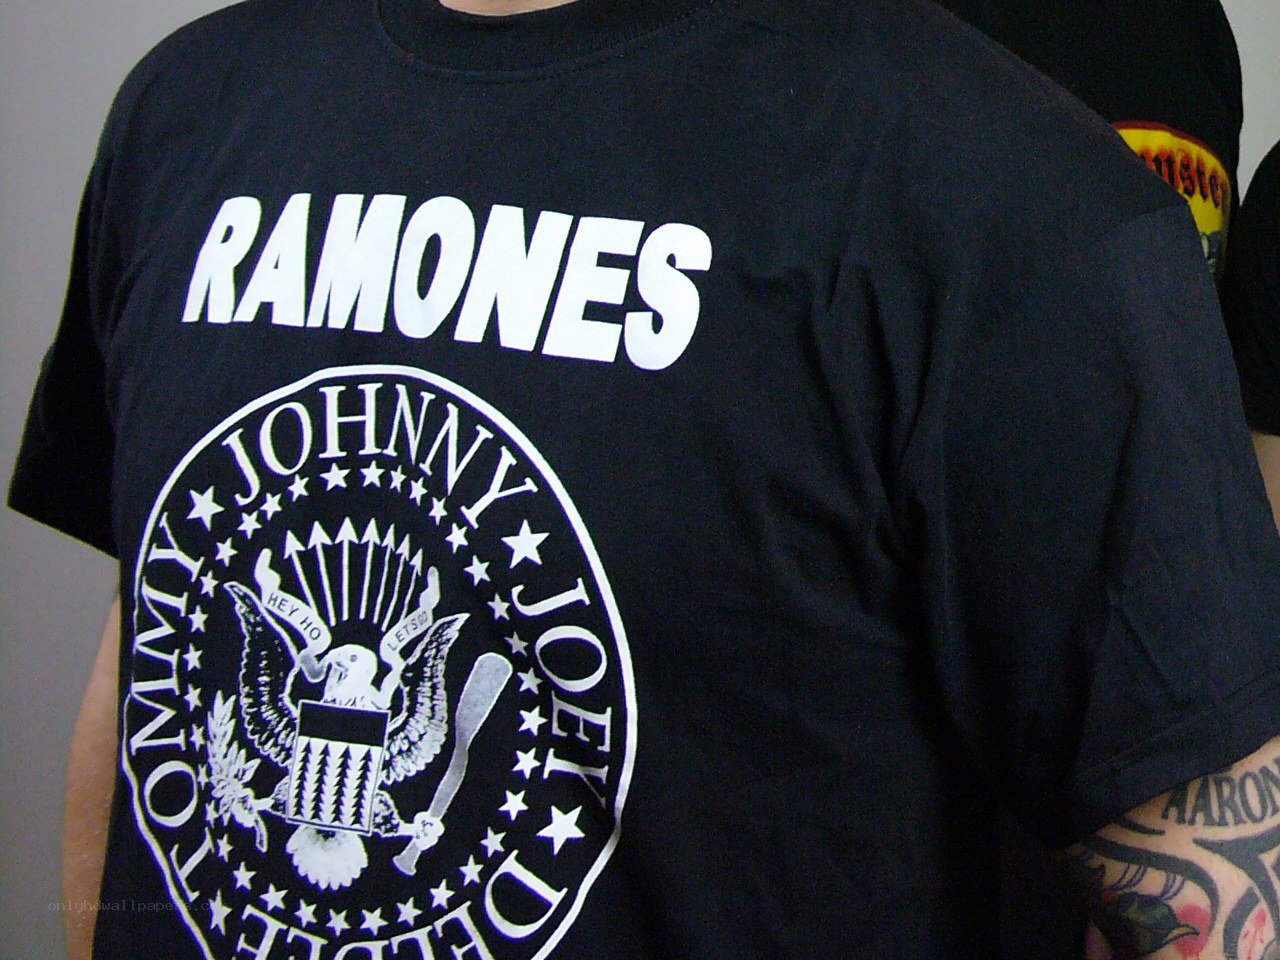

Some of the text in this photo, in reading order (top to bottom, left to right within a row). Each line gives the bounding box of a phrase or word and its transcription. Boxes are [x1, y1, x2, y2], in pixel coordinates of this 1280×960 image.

[181, 192, 713, 371] RAMONES
[221, 382, 538, 530] JOHNNY
[267, 592, 320, 640] HEY HO
[509, 577, 612, 810] JOEY
[129, 510, 220, 904] TOMMY
